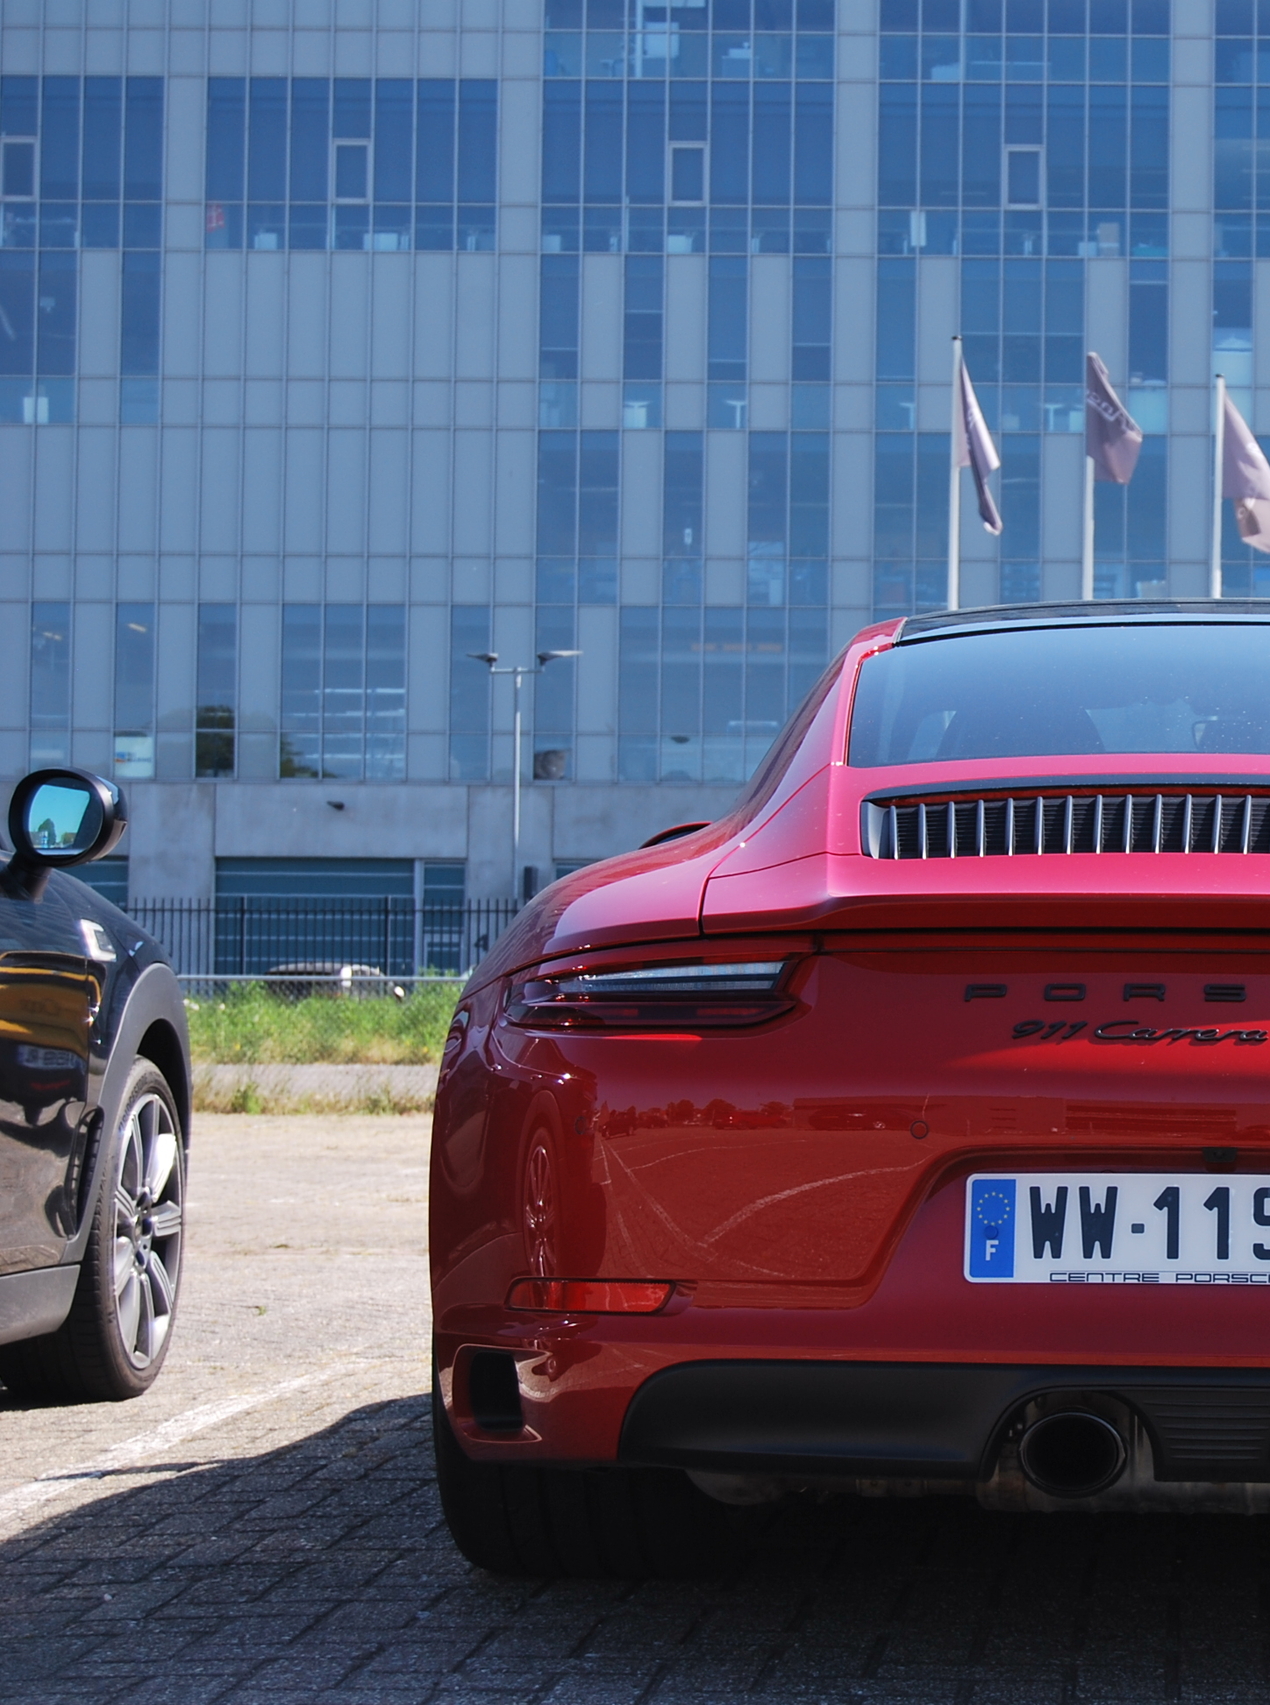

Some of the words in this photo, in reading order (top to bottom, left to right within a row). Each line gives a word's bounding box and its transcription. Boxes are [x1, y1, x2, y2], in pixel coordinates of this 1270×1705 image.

[1011, 1020, 1087, 1039] 911
[1094, 1020, 1268, 1041] Carrera
[985, 1240, 999, 1261] F
[1050, 1272, 1160, 1283] CENTRE
